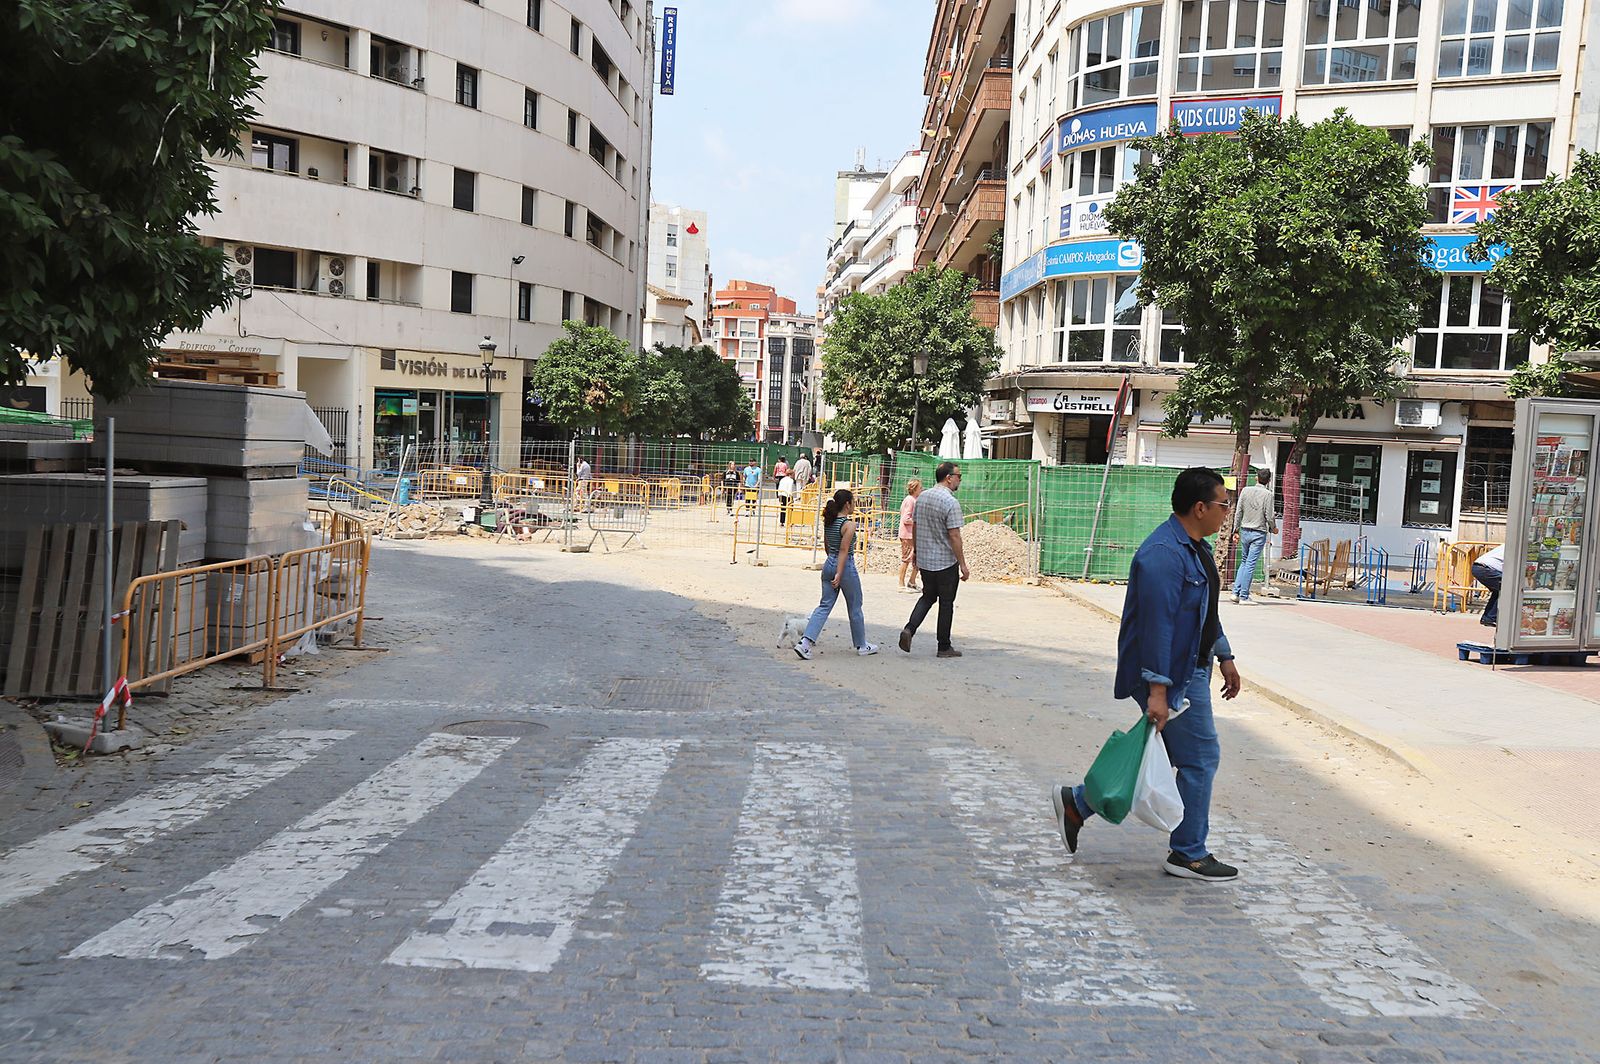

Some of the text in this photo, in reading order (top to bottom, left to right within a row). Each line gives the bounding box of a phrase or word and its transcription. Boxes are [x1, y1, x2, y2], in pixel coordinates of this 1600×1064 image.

[665, 49, 673, 86] HUELVA
[1177, 108, 1203, 127] KIDS
[1205, 106, 1236, 126] CLUB
[1063, 128, 1096, 148] IDIOMAS
[1101, 121, 1148, 139] HUELVA
[1080, 220, 1106, 231] HUELVA
[1058, 252, 1084, 265] CAMPOS
[1084, 250, 1116, 264] Abogados
[398, 357, 448, 377] VISIÓN
[452, 367, 466, 379] DE
[467, 368, 478, 379] LA
[1064, 402, 1115, 411] ESTRELL
